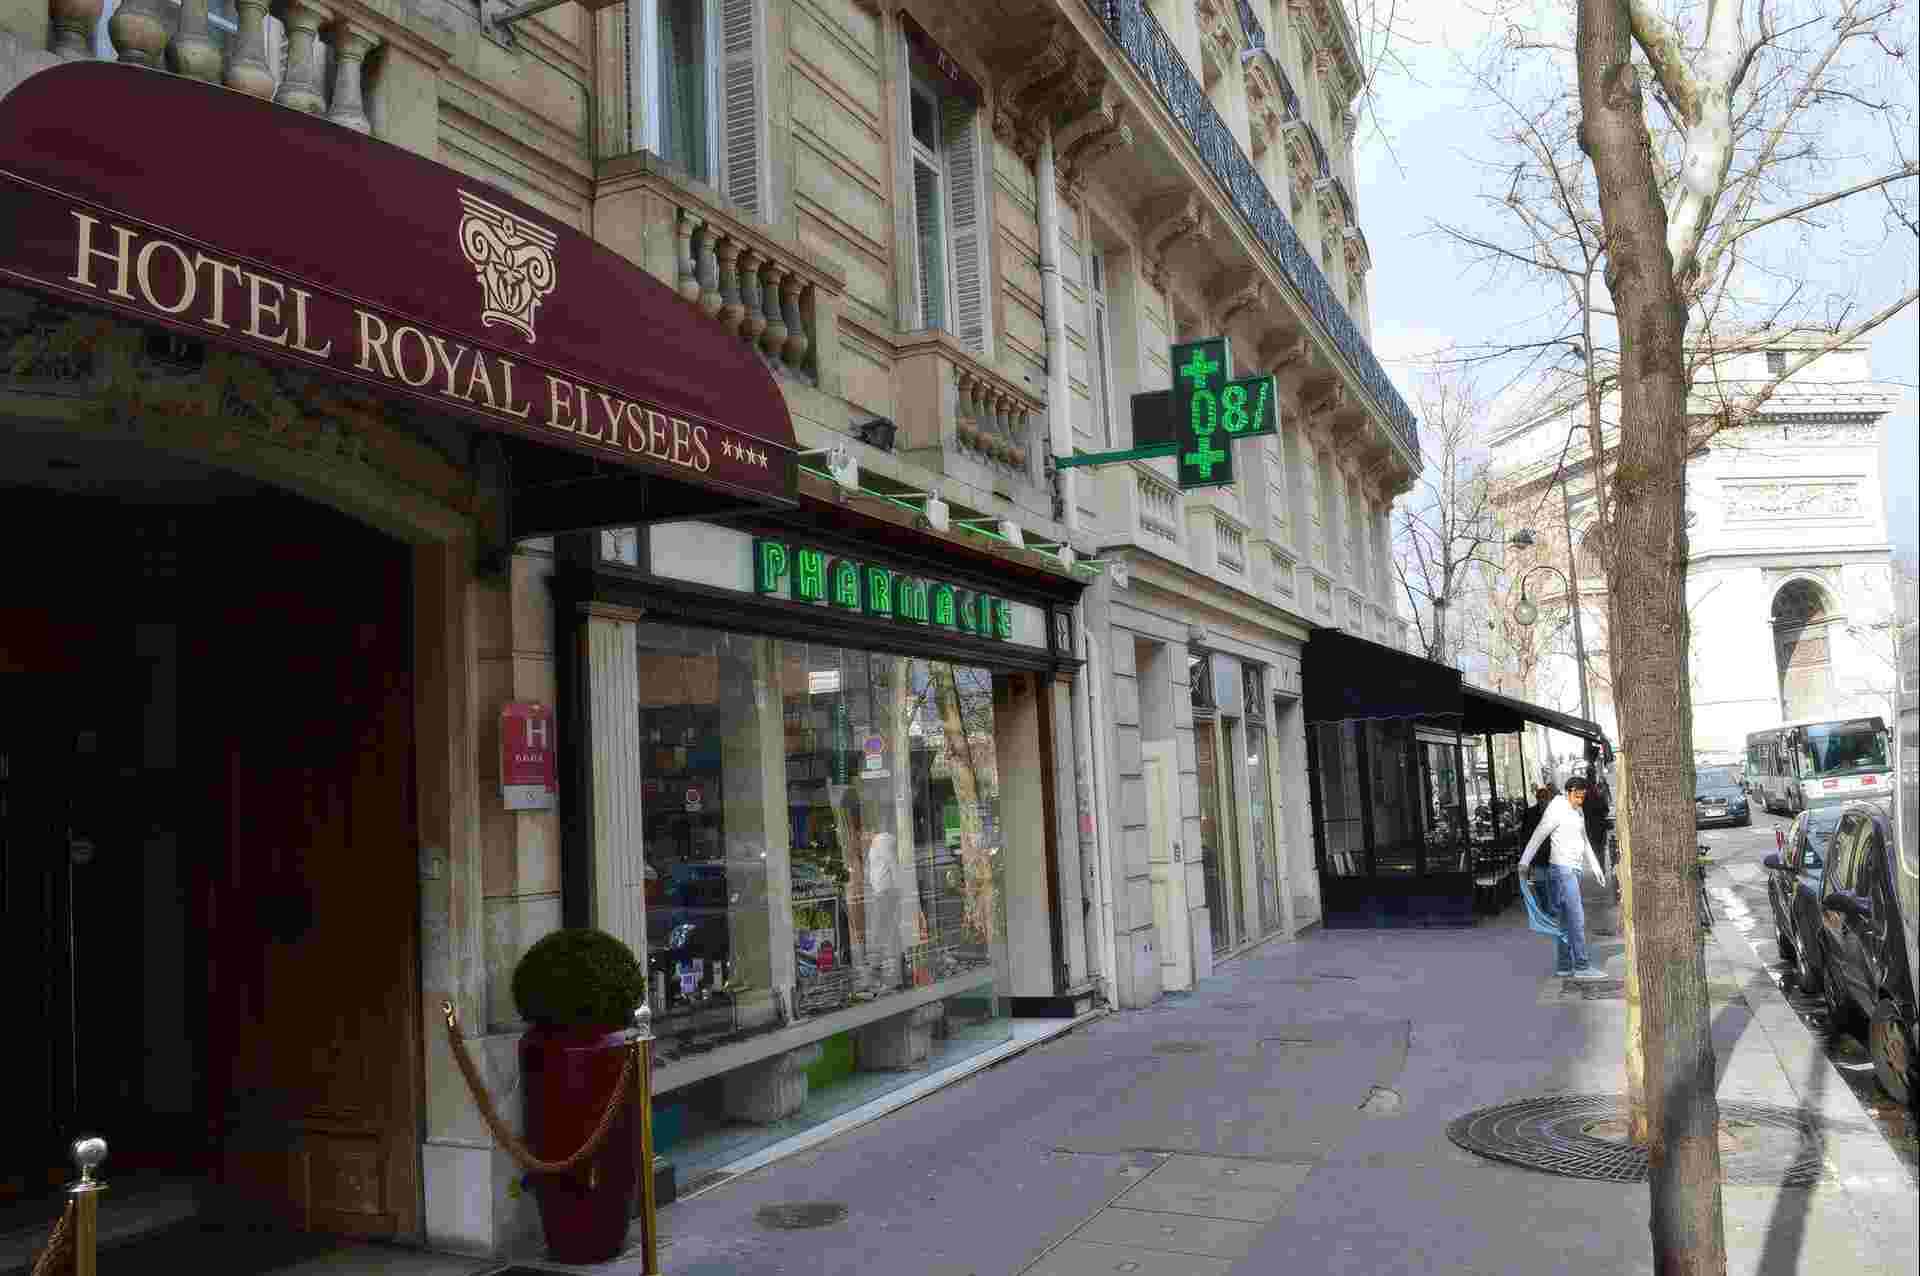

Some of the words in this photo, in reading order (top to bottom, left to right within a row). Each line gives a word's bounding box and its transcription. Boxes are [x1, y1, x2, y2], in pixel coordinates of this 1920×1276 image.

[67, 209, 332, 359] HOTEL
[353, 309, 532, 419] ROYAL
[544, 374, 712, 473] ELYSEES
[758, 541, 1012, 639] PHARMACIE
[526, 719, 547, 749] H
